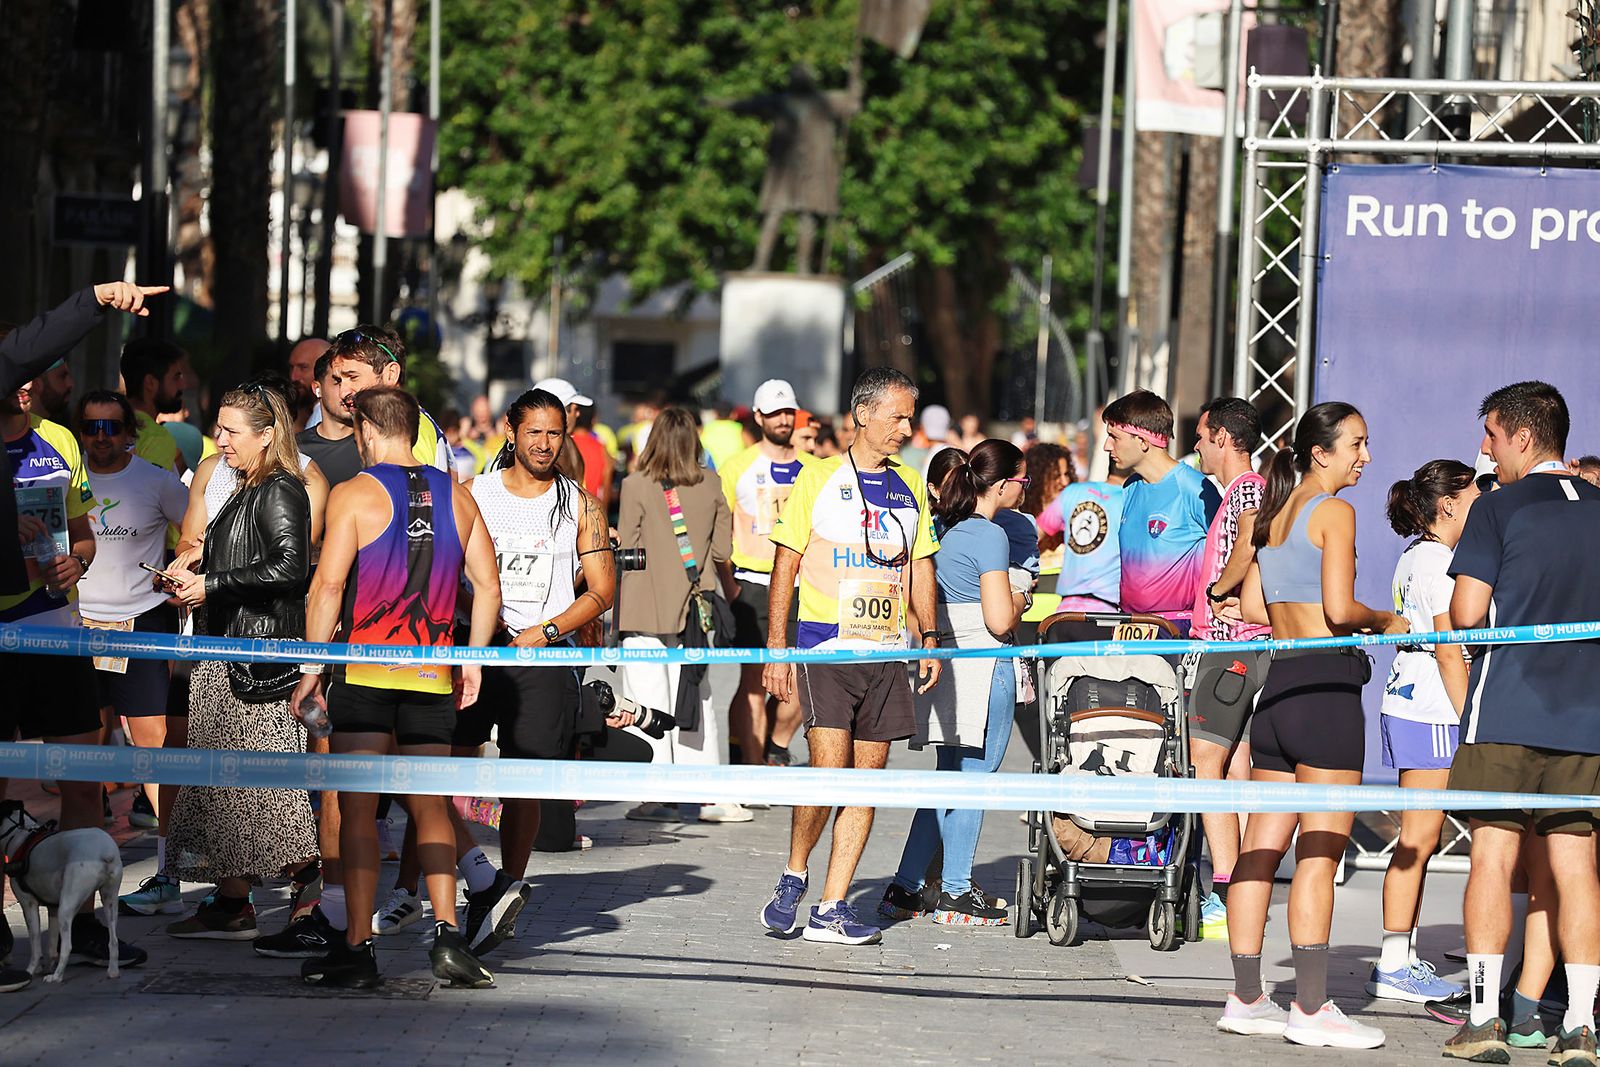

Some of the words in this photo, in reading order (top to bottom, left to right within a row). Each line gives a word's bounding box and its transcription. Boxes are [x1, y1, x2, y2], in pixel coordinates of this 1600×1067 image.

[1346, 195, 1448, 237] Run
[1461, 198, 1517, 240] to
[22, 507, 62, 529] 75
[860, 509, 889, 532] 21K
[852, 597, 892, 620] 909
[1470, 630, 1517, 640] HUELVA
[23, 638, 69, 649] HUELVA
[284, 647, 330, 657] HUELVA
[369, 649, 414, 658] HUELVA
[454, 650, 500, 659] HUELVA
[538, 650, 584, 659] HUELVA
[623, 649, 668, 658] HUELVA
[707, 648, 752, 657] HUELVA
[418, 671, 437, 680] Sevilla
